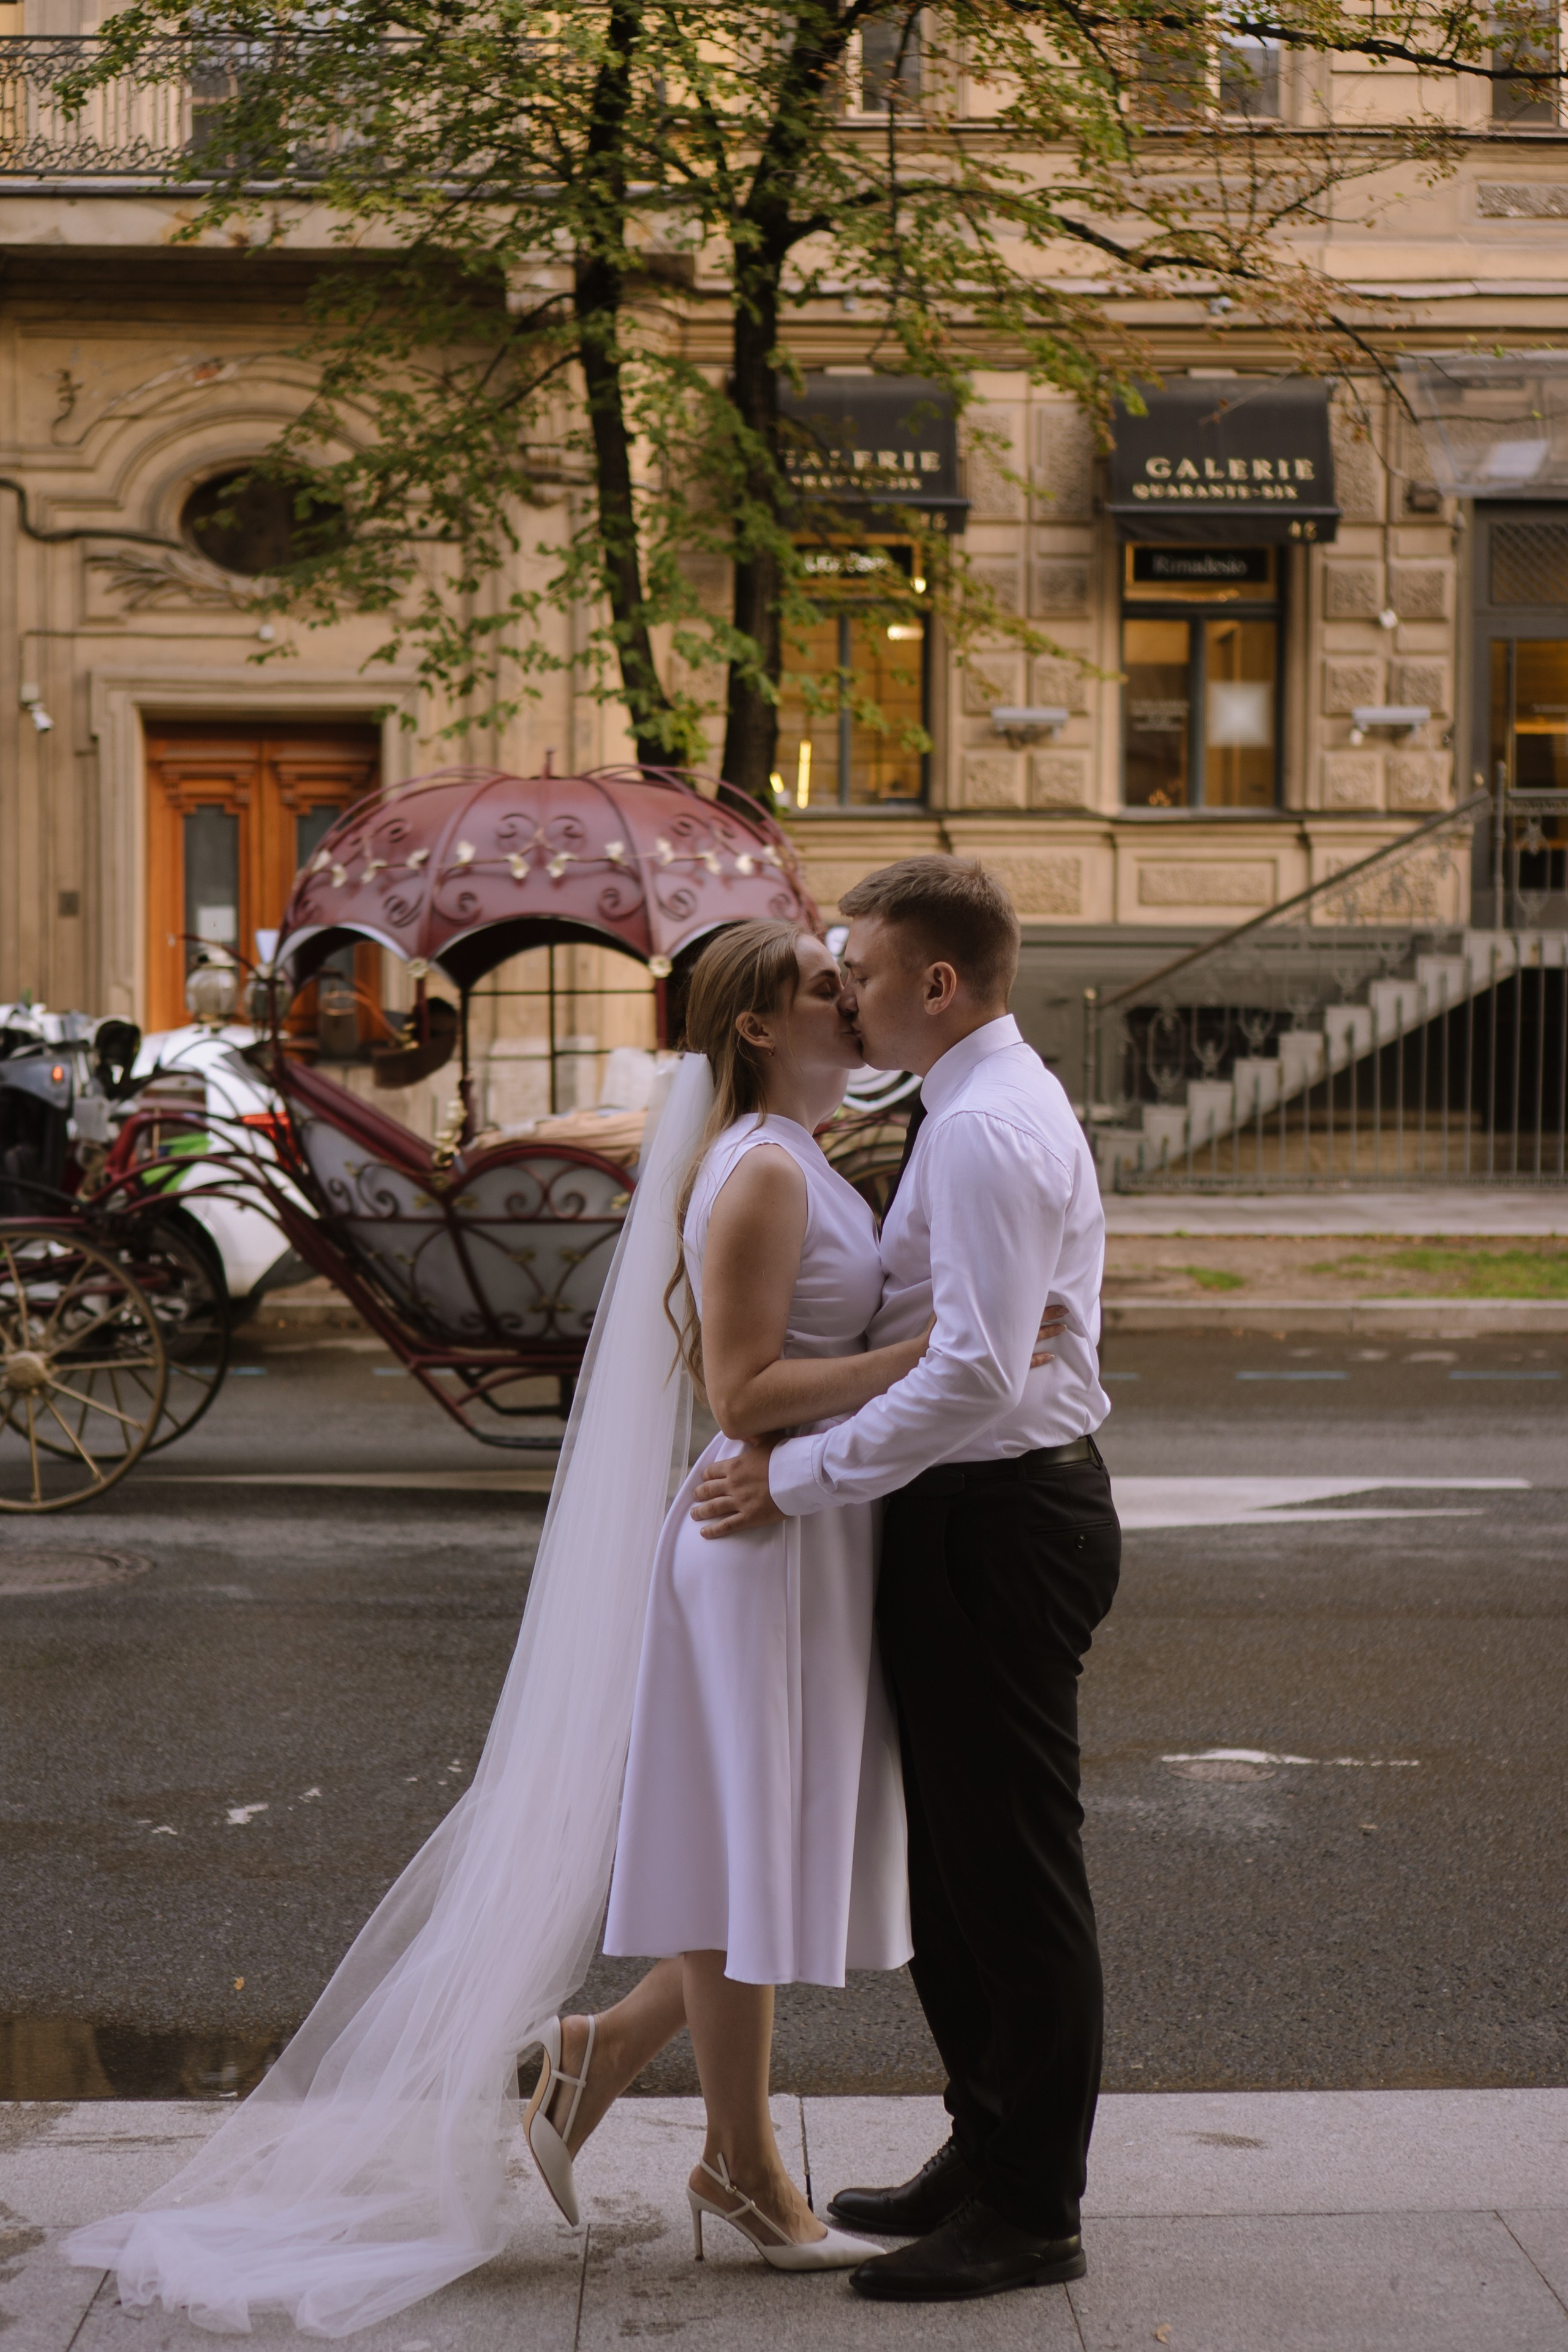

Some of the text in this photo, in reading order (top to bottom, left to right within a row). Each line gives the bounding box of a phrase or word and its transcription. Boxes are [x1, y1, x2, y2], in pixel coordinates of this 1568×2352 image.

[1145, 456, 1316, 480] GALERIE
[1132, 483, 1298, 500] QUARANTE-SIX
[1287, 520, 1317, 540] 46
